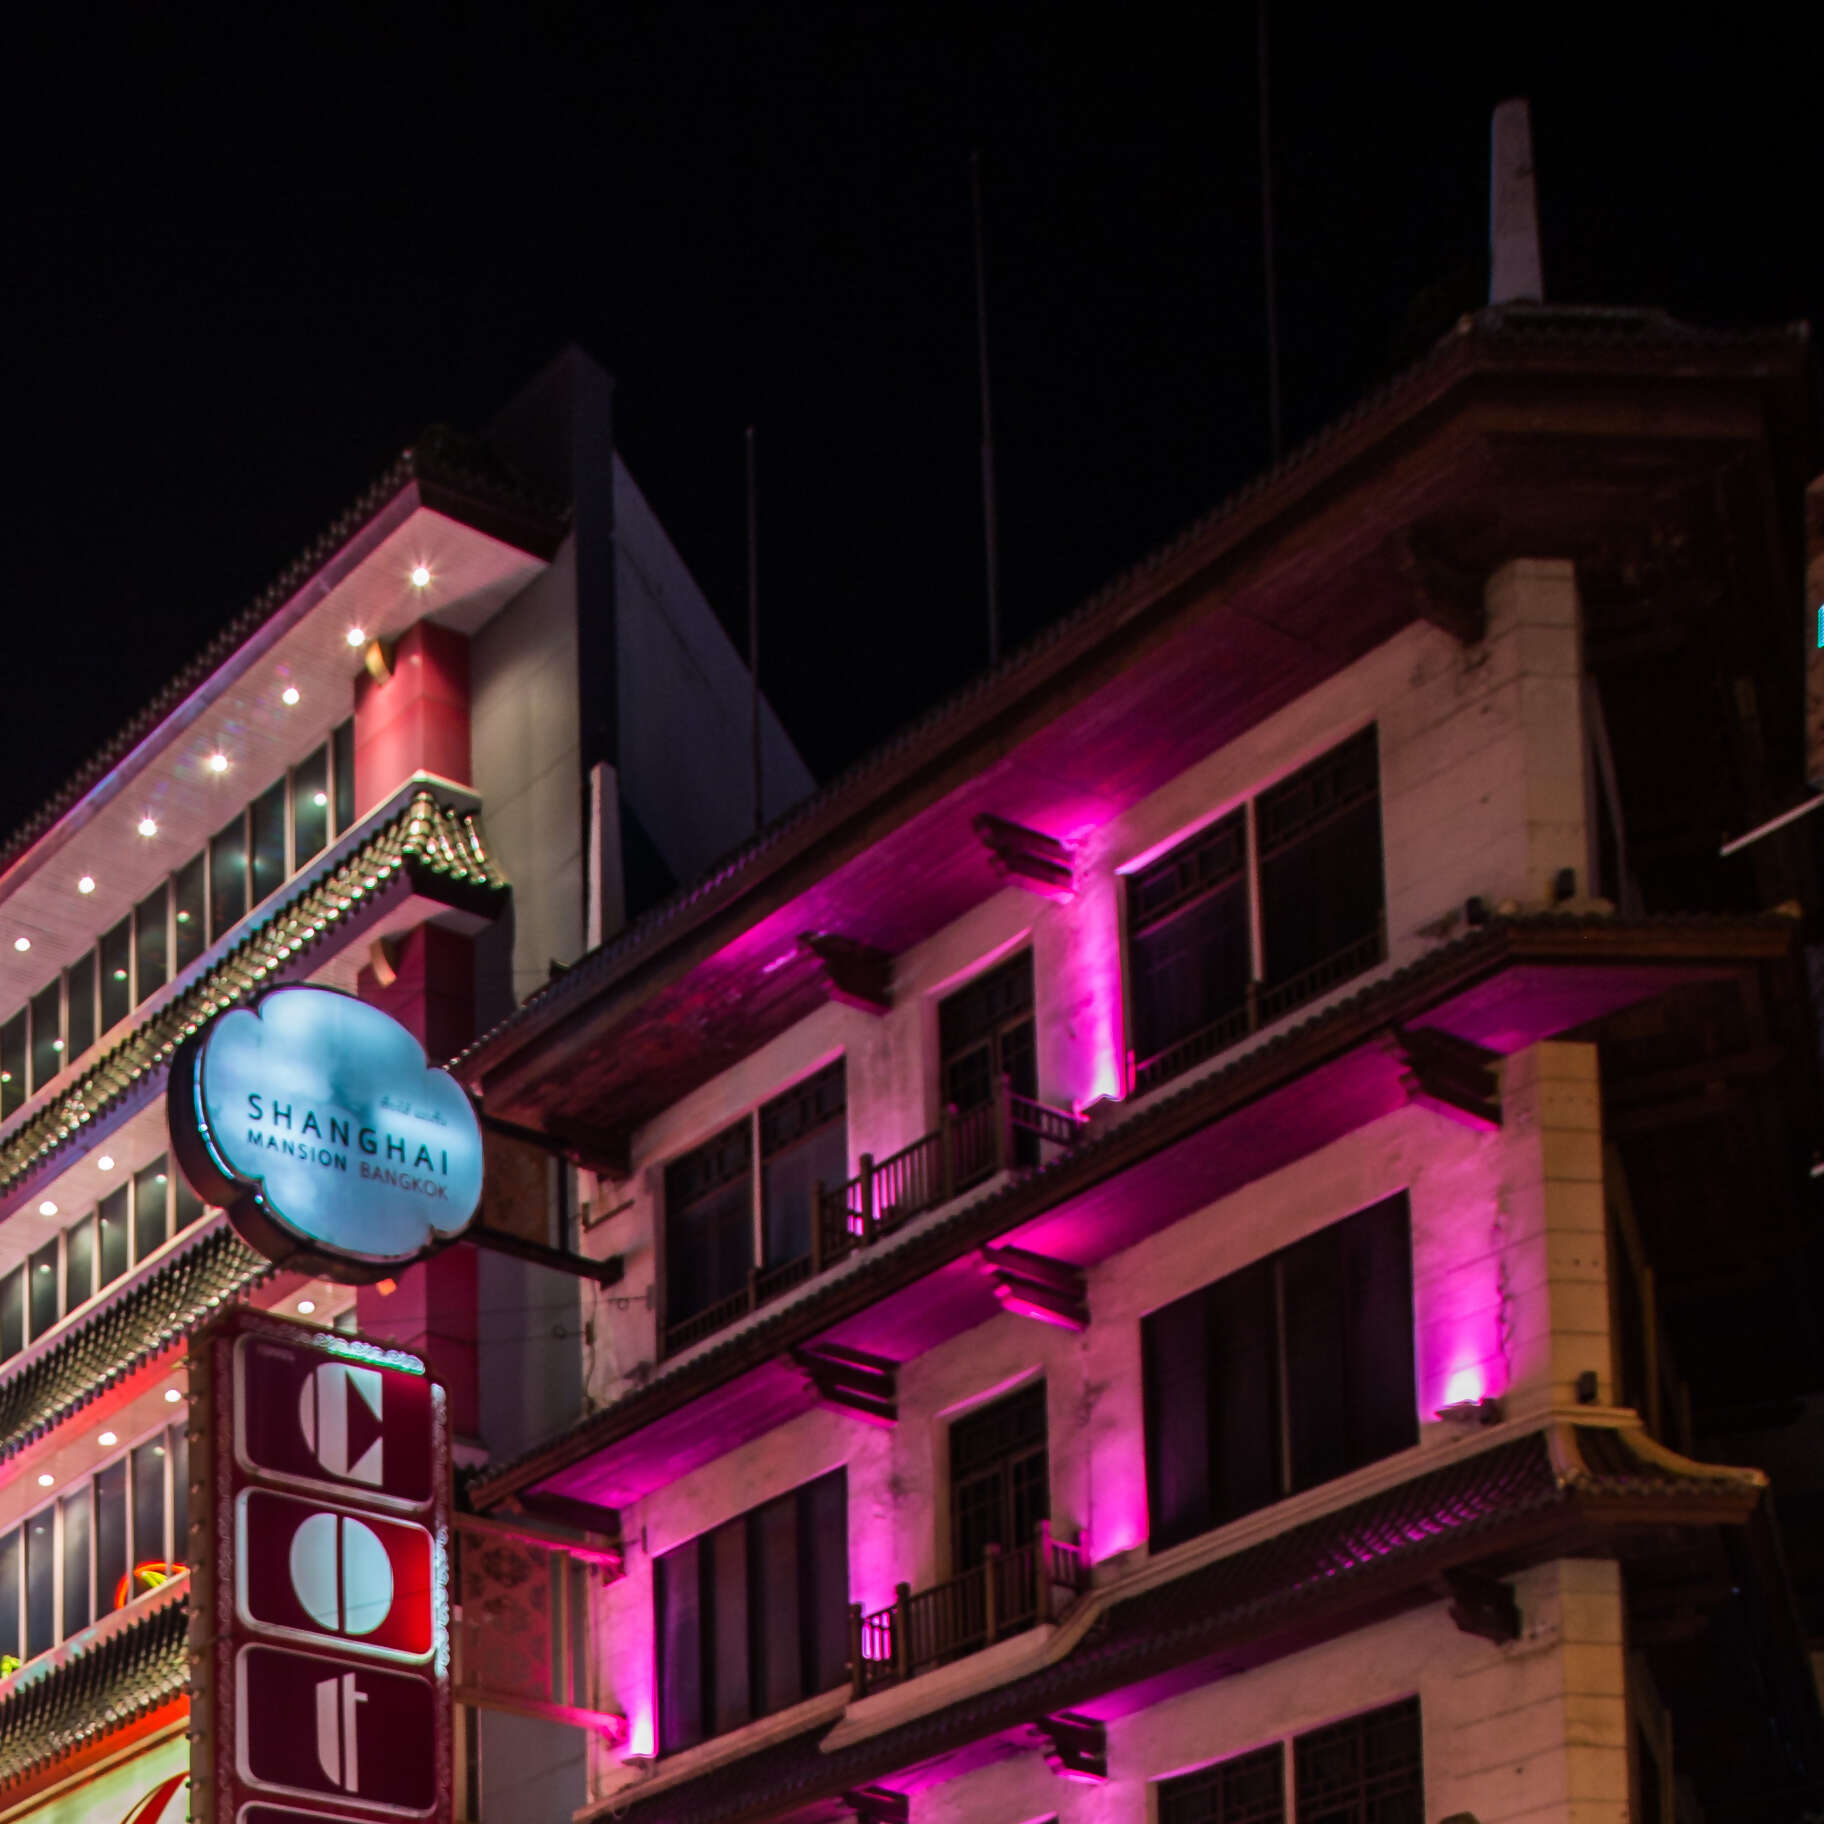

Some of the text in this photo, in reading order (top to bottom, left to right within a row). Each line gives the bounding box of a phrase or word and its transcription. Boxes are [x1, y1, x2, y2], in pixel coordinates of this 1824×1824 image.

[247, 1092, 449, 1177] SHANGHAI
[247, 1129, 449, 1200] MANSION BANGKOK
